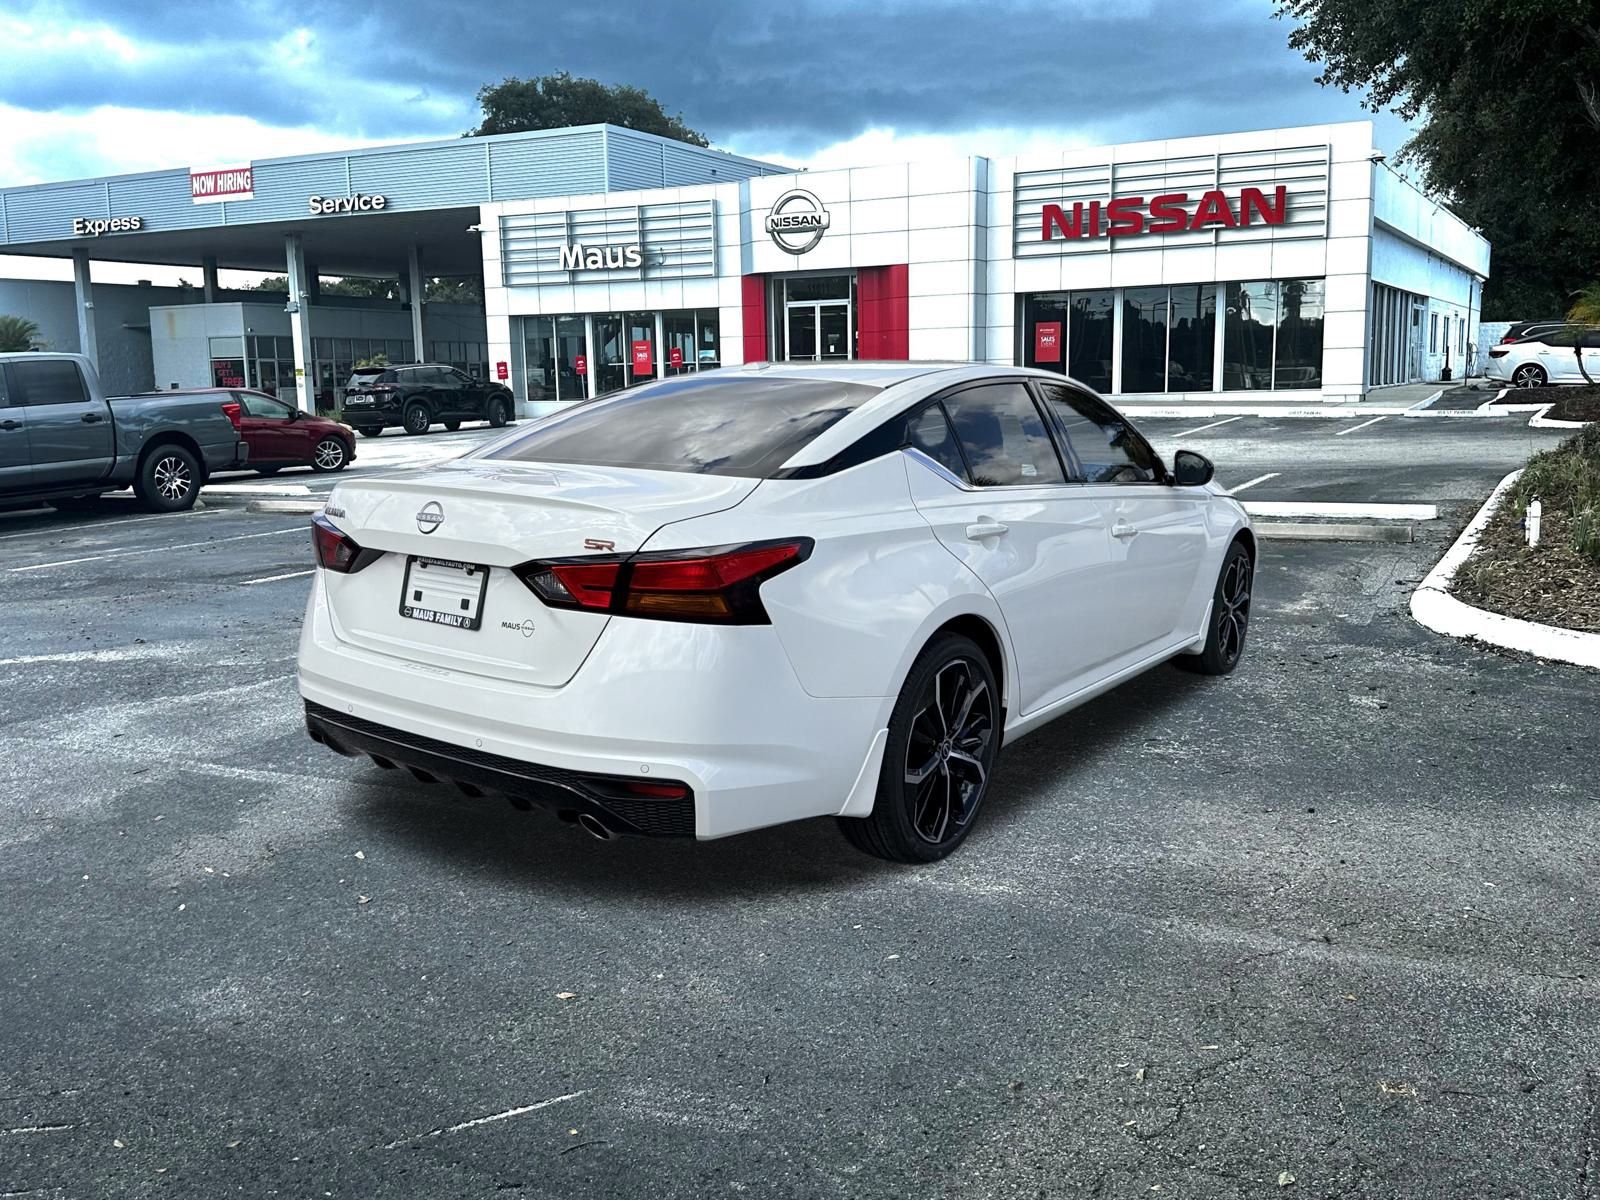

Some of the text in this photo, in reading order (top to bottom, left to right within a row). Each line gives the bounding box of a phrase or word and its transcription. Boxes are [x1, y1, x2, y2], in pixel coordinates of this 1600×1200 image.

[192, 171, 251, 195] NOW HIRING
[309, 193, 385, 214] Service
[1042, 185, 1287, 241] NISSAN
[73, 216, 141, 237] Express
[771, 215, 821, 228] NISSAN
[560, 243, 642, 270] Maus
[223, 377, 244, 386] FREE
[584, 538, 615, 552] SR
[412, 608, 463, 627] MAUS FAMILY
[501, 621, 521, 630] MAUS
